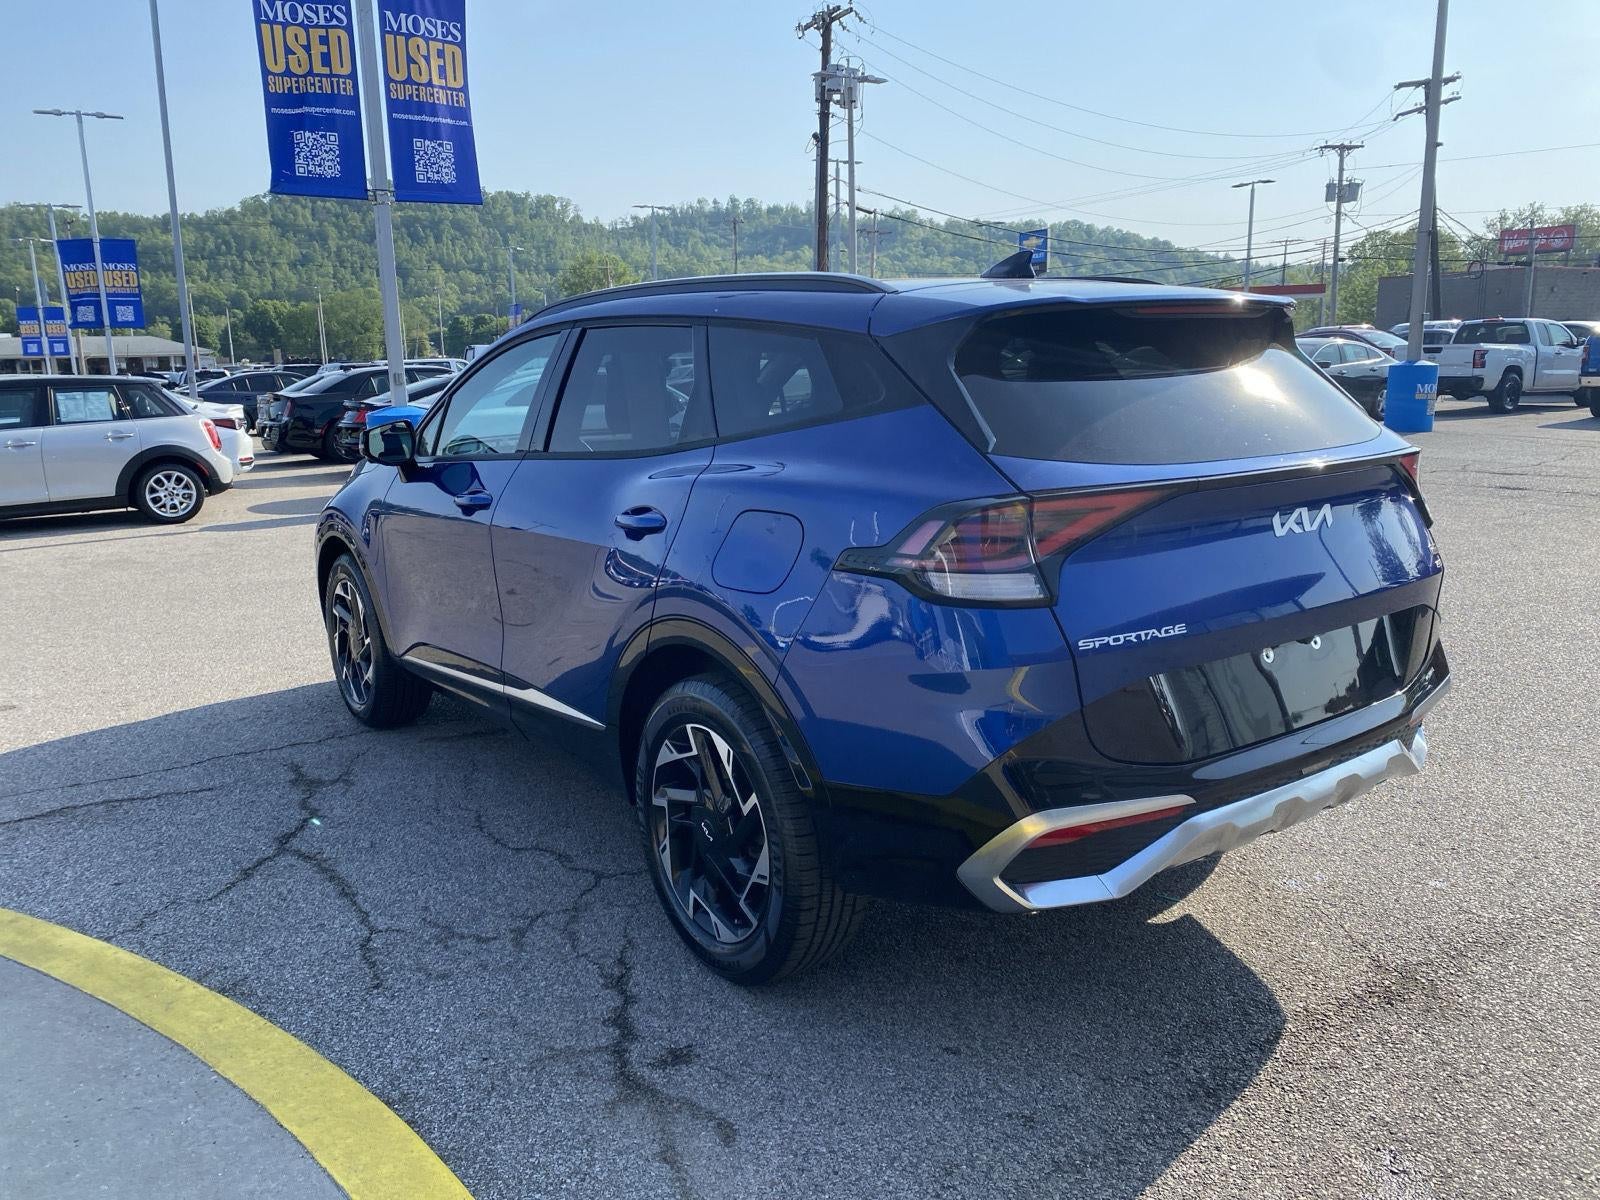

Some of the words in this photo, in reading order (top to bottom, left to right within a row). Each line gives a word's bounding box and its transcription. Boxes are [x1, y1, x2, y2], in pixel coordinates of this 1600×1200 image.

[260, 0, 348, 26] MOSES
[384, 10, 461, 43] MOSES
[261, 23, 352, 76] USED
[385, 34, 464, 88] USED
[268, 75, 354, 96] SUPERCENTER
[389, 82, 466, 108] SUPERCENTER
[271, 105, 356, 117] mosesusedsupercenter.com
[392, 112, 469, 127] mosesusedsupercenter.com
[64, 263, 96, 271] MOSES
[65, 271, 98, 288] USED
[104, 270, 138, 288] USED
[1272, 503, 1334, 538] KIA
[1078, 623, 1187, 651] SPORTAGE
